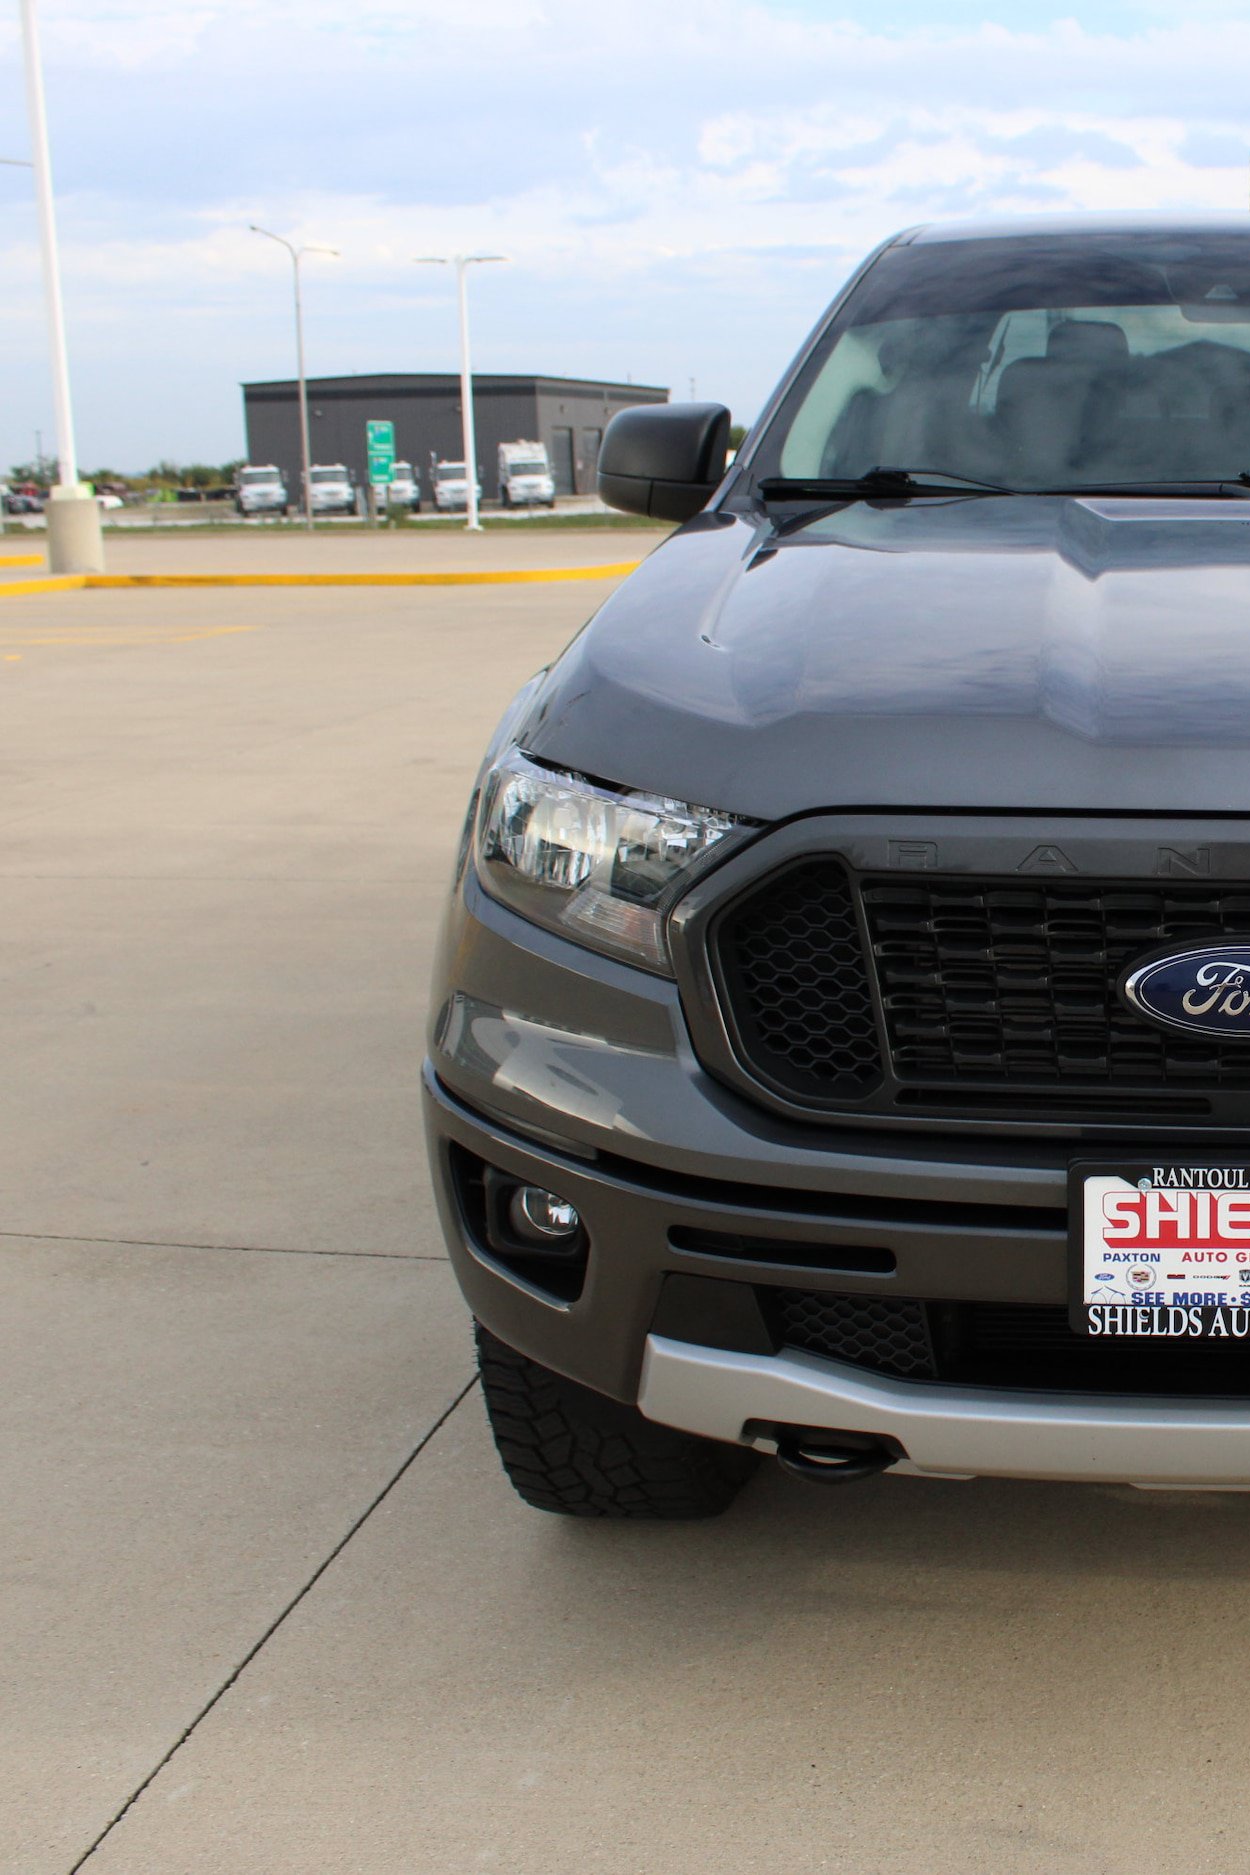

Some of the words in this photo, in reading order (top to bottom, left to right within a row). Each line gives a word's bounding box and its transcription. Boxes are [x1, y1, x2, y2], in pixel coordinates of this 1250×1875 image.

[1152, 1167, 1249, 1189] RANTOUL
[1102, 1252, 1161, 1263] PAXTON
[1181, 1251, 1228, 1263] AUTO
[1131, 1291, 1165, 1306] SEE
[1172, 1292, 1228, 1307] MORE
[1087, 1305, 1203, 1337] SHIELDS
